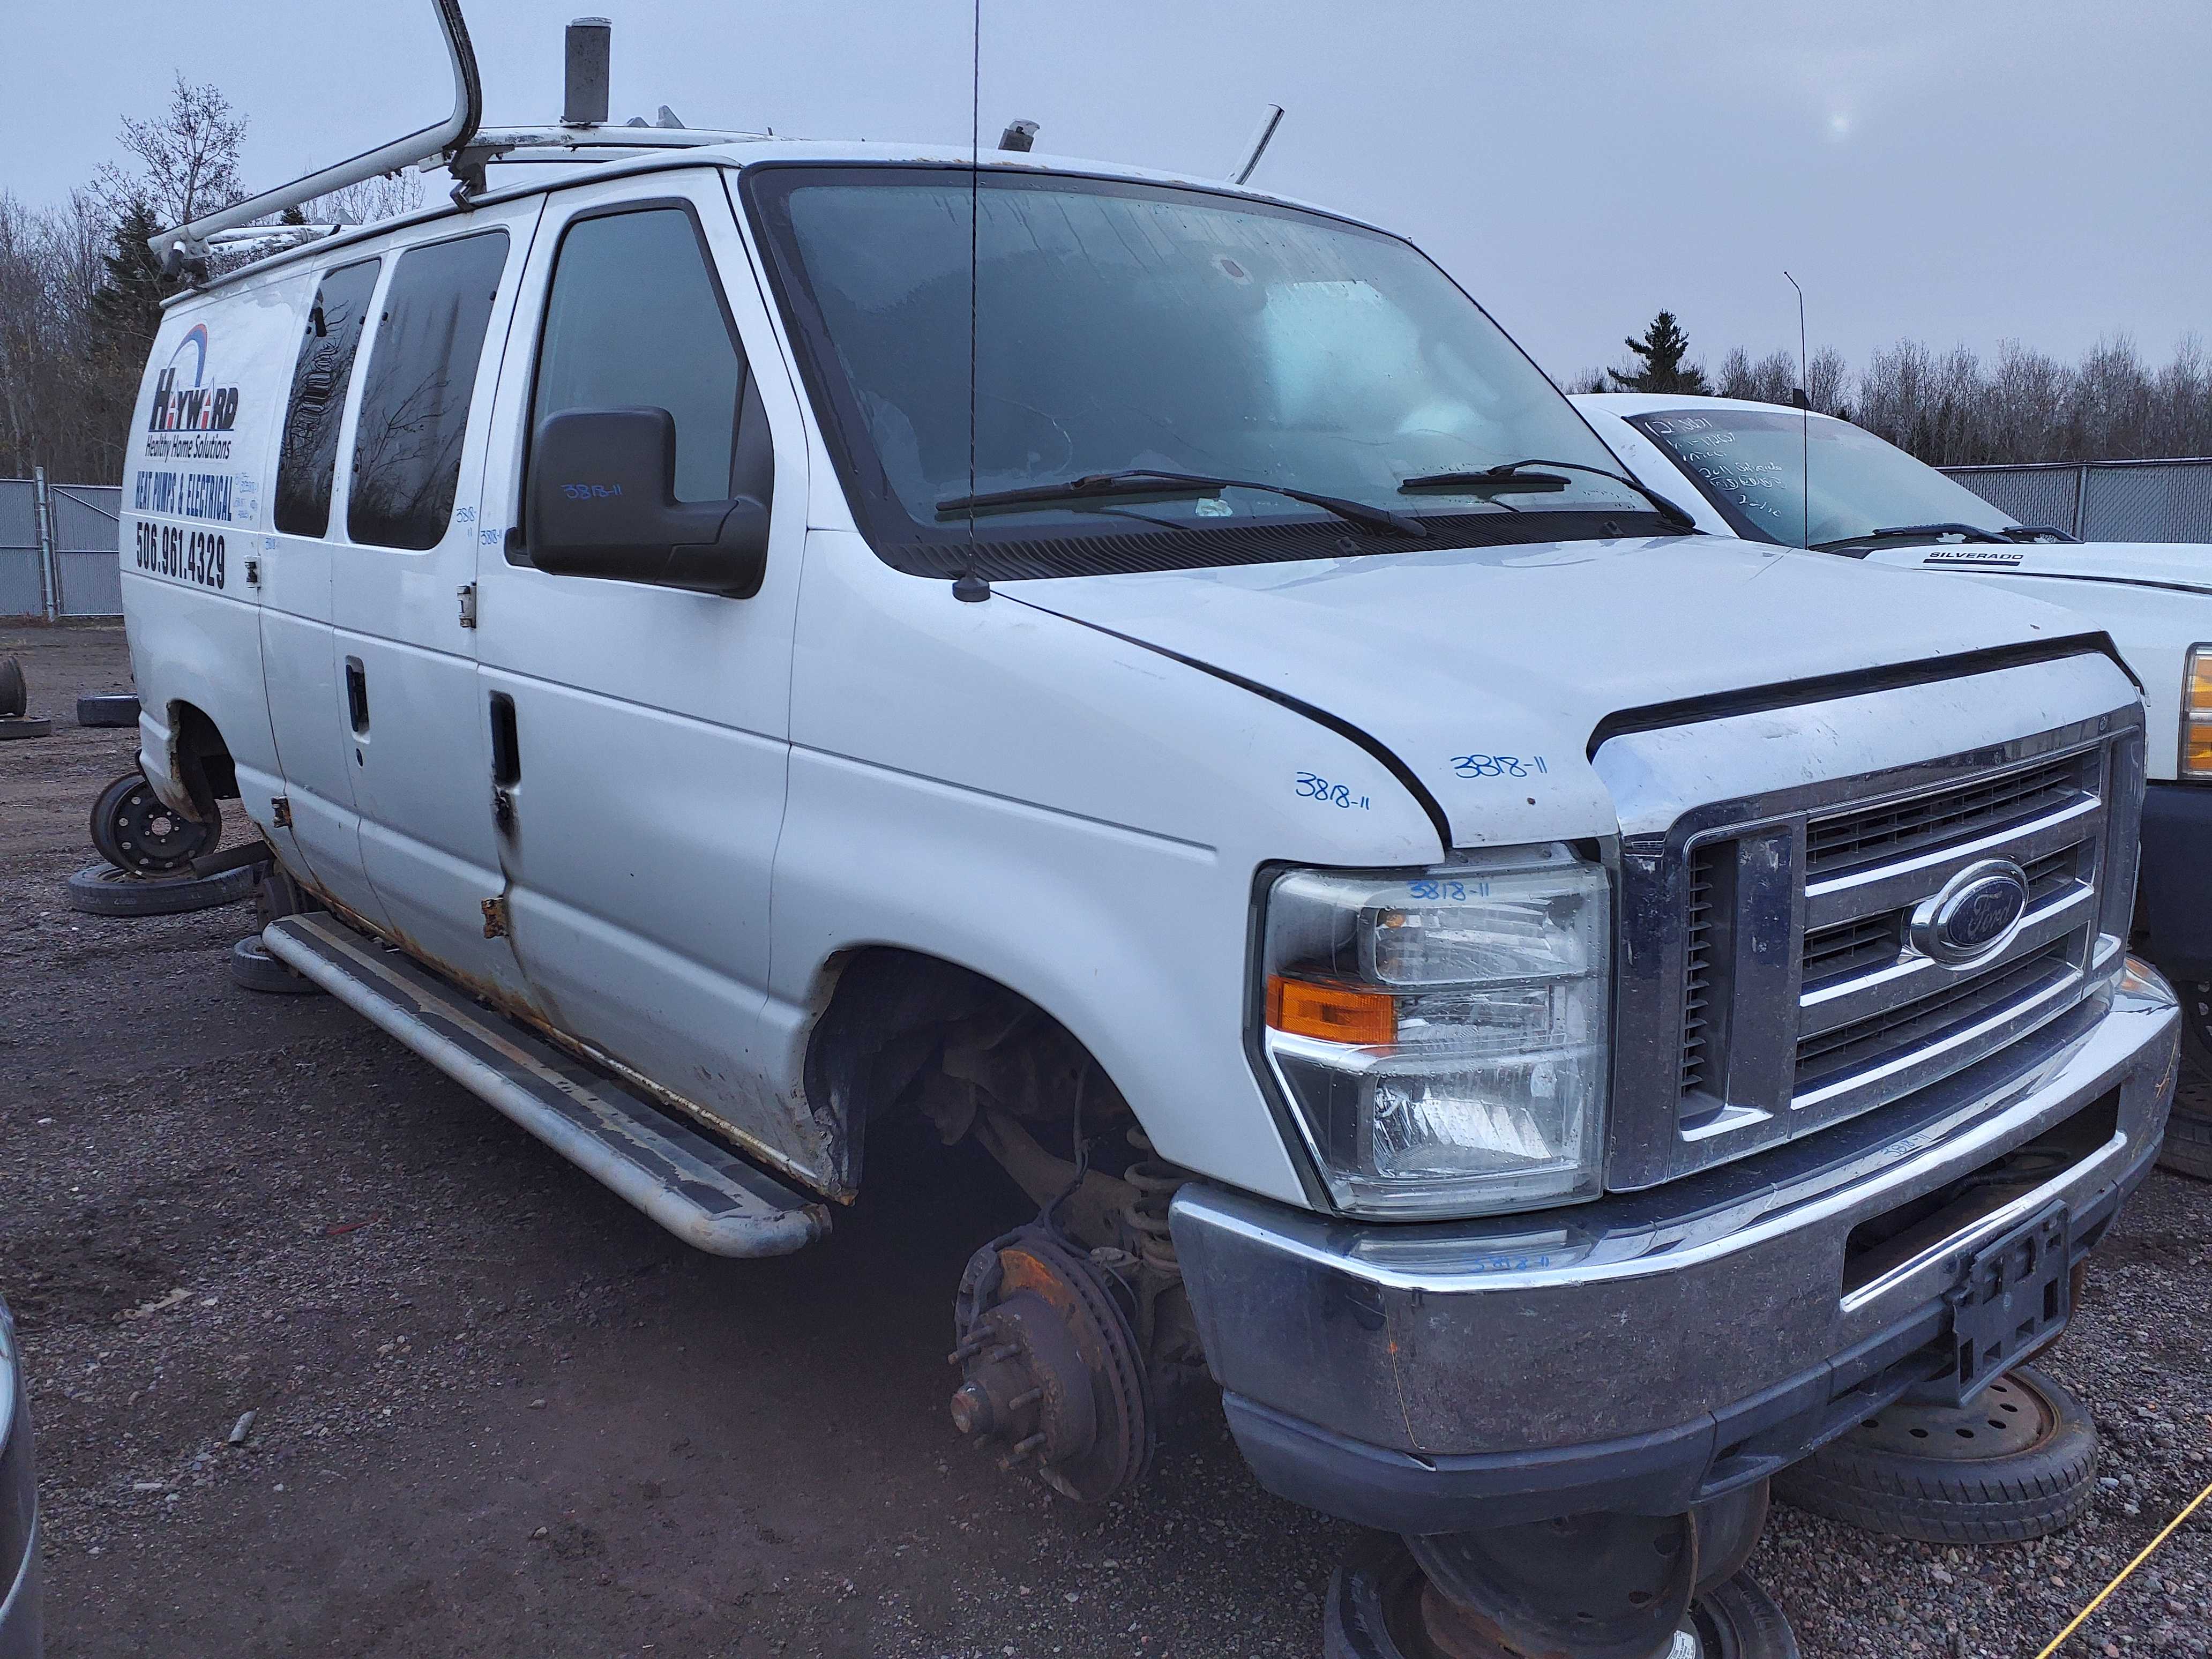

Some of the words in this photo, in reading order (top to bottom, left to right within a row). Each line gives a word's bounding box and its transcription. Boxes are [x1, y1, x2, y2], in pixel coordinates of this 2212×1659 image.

[145, 433, 171, 463] Healthy
[171, 435, 193, 458] Home
[193, 433, 231, 460] Solutions
[135, 471, 153, 510] HEAT
[153, 472, 176, 514] PUMPS
[186, 474, 233, 521] ELECTRICAL
[136, 521, 225, 589] 506.961.4329
[1449, 754, 1548, 779] 3818-11
[1295, 771, 1370, 810] 3818-11
[1406, 879, 1492, 901] 3818-11
[1967, 890, 2014, 936] Ford
